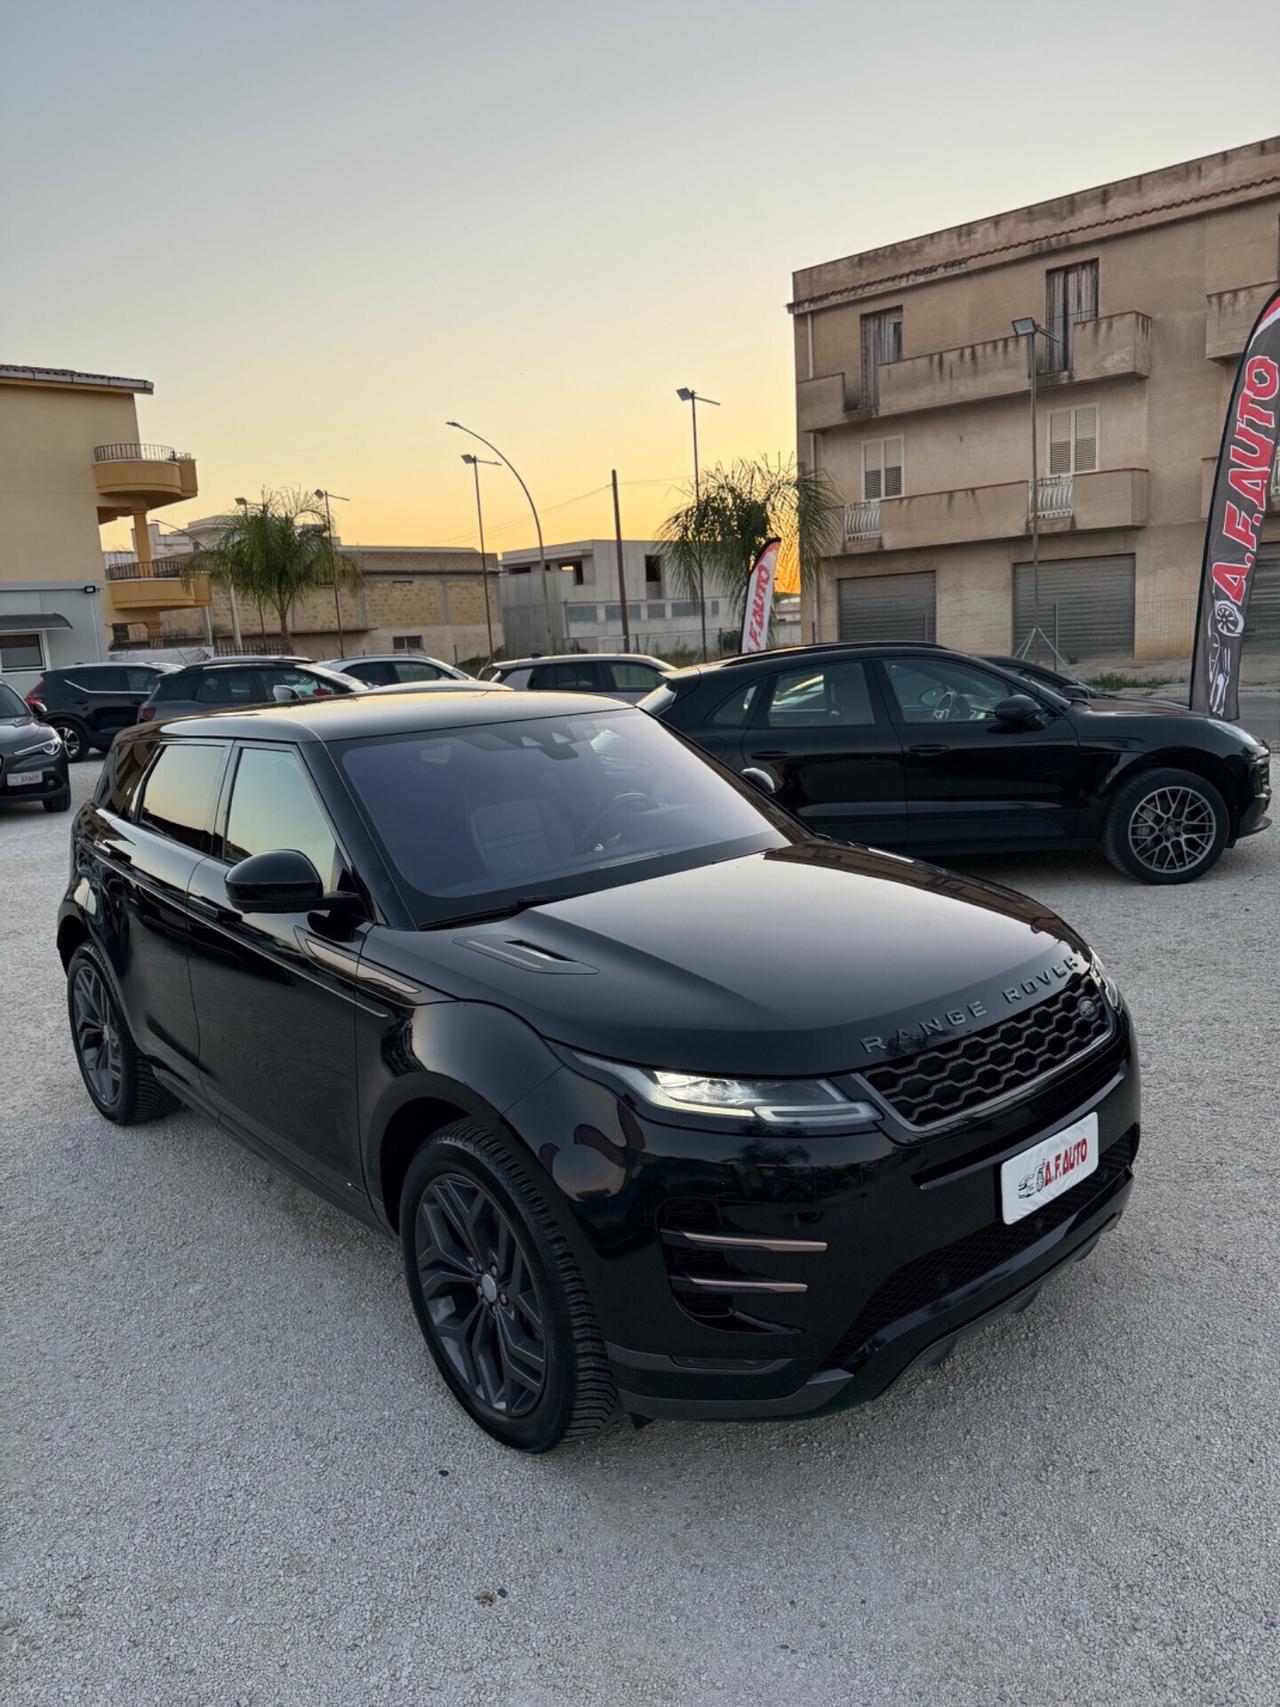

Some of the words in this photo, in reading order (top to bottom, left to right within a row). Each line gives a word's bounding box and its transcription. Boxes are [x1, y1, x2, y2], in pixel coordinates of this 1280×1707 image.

[1212, 355, 1279, 605] A.F.AUTO
[860, 1001, 988, 1053] RANGE
[1002, 956, 1079, 1004] ROVER
